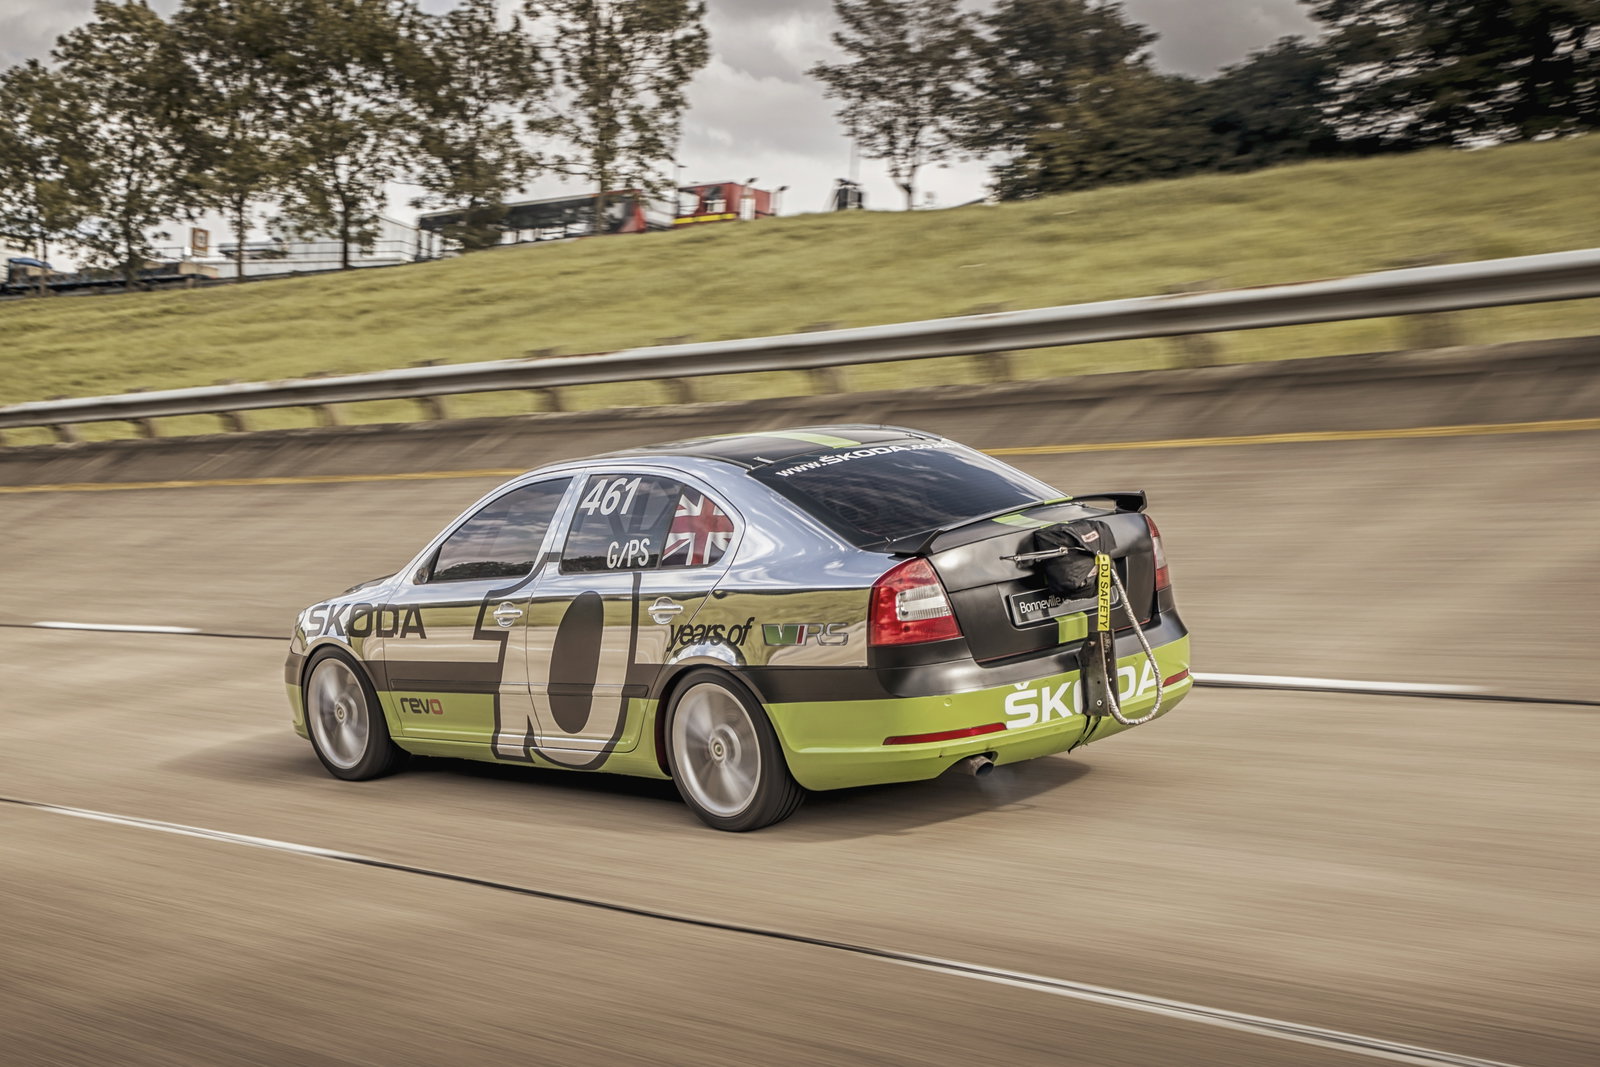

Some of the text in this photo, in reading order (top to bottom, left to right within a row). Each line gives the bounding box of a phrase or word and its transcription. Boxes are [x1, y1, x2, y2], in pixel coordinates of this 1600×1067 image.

[580, 477, 642, 516] 461
[606, 538, 650, 569] G/PS
[1100, 563, 1109, 577] DJ
[1019, 595, 1061, 614] Bonneville
[1100, 581, 1109, 628] SAFETY
[473, 552, 642, 771] 10
[666, 623, 725, 652] years
[727, 617, 755, 647] of
[400, 697, 443, 715] revo
